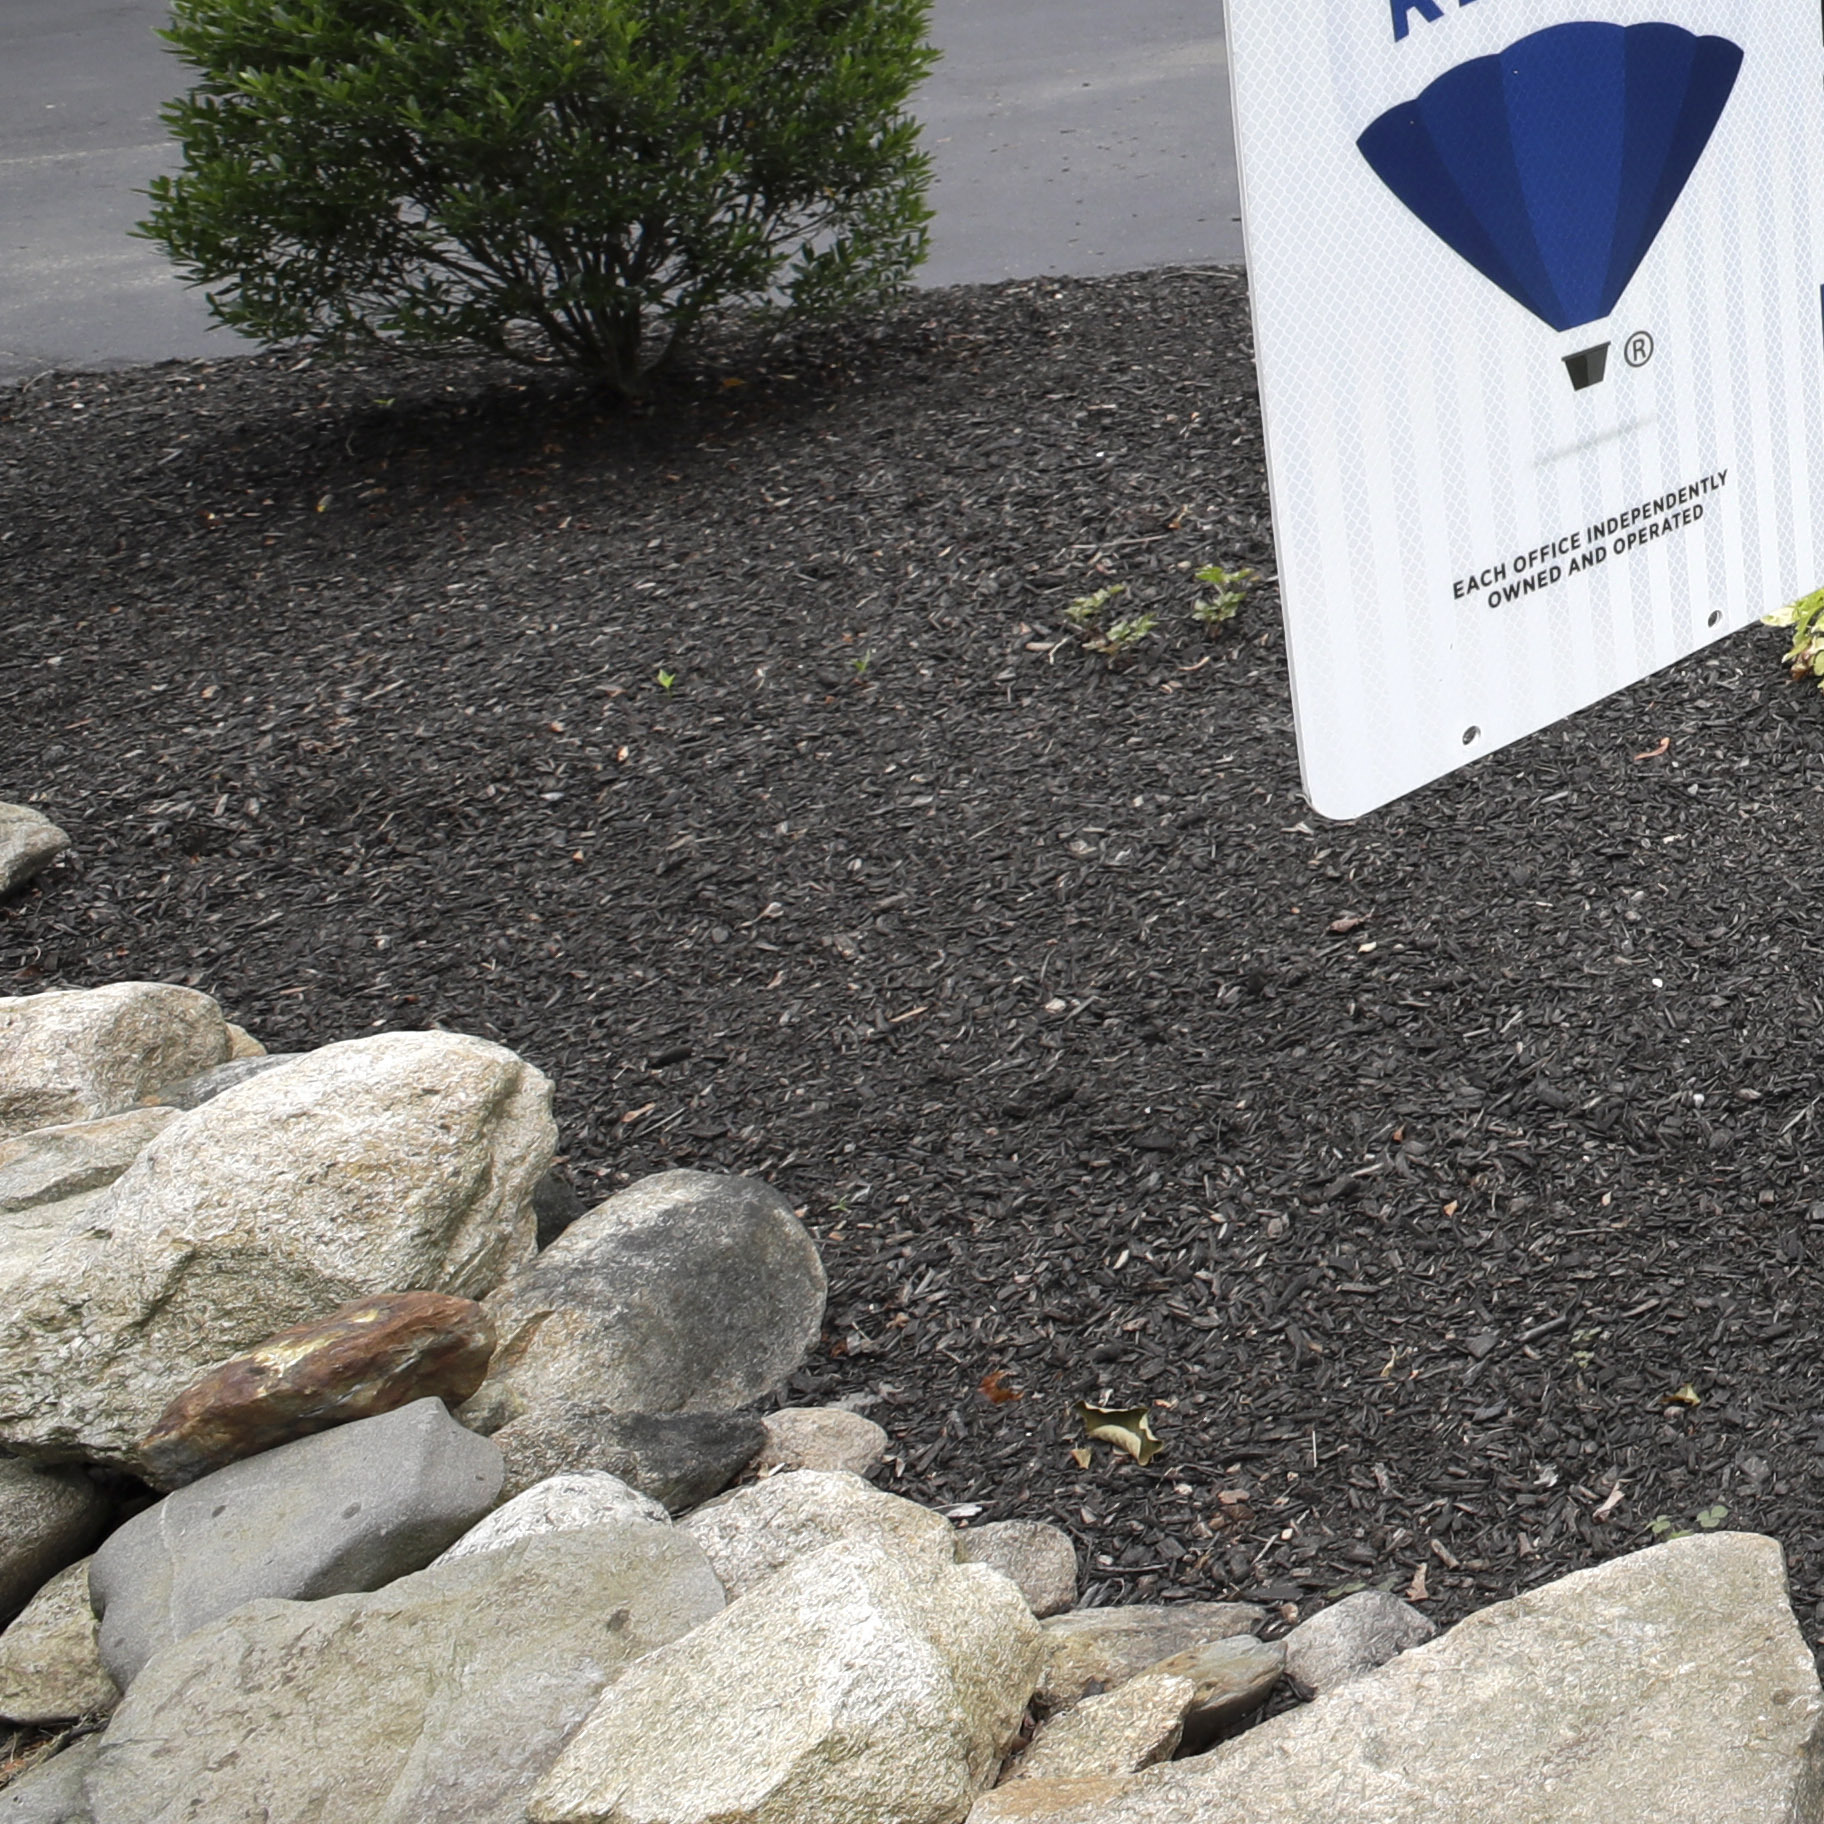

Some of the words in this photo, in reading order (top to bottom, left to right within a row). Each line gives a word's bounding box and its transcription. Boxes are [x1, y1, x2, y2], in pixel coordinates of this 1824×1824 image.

[1452, 562, 1507, 600] EACH
[1513, 531, 1582, 574] OFFICE
[1586, 469, 1729, 544] INDEPENDENTLY
[1487, 565, 1562, 609] OWNED
[1568, 546, 1608, 576] AND
[1613, 504, 1705, 555] OPERATED
